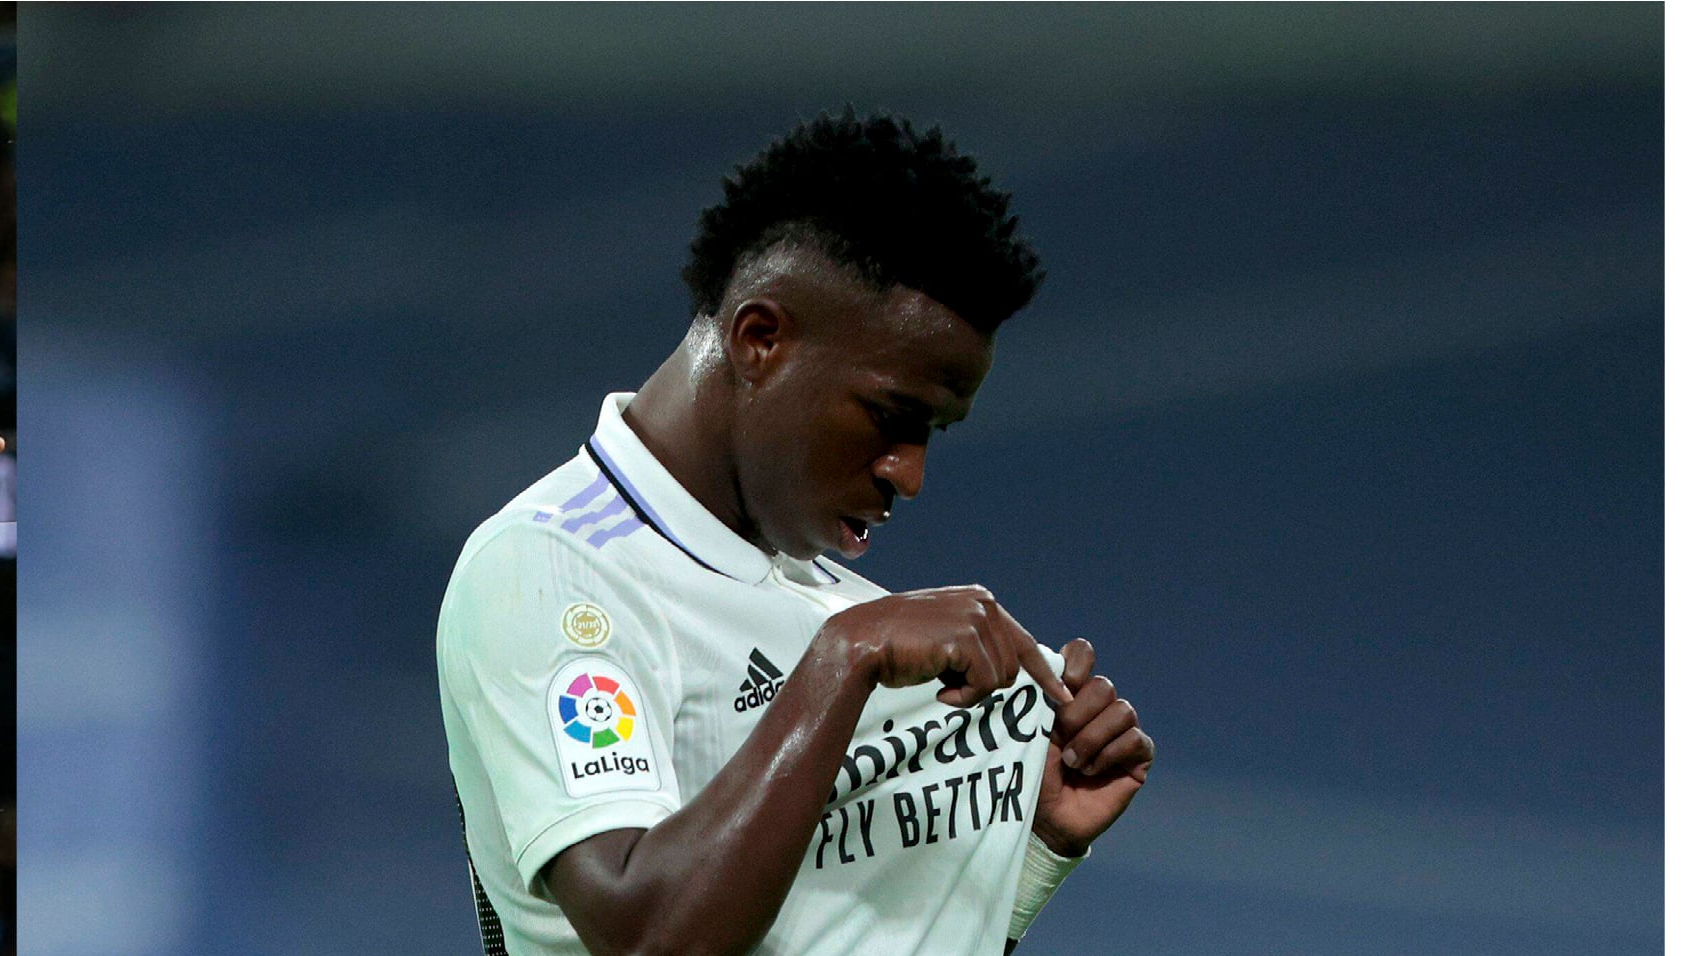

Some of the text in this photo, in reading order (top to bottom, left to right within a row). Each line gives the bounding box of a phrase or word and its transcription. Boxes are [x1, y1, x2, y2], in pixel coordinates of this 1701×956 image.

[734, 680, 785, 713] adid
[571, 751, 650, 779] LaLiga
[815, 761, 1024, 869] FLY BETTER
